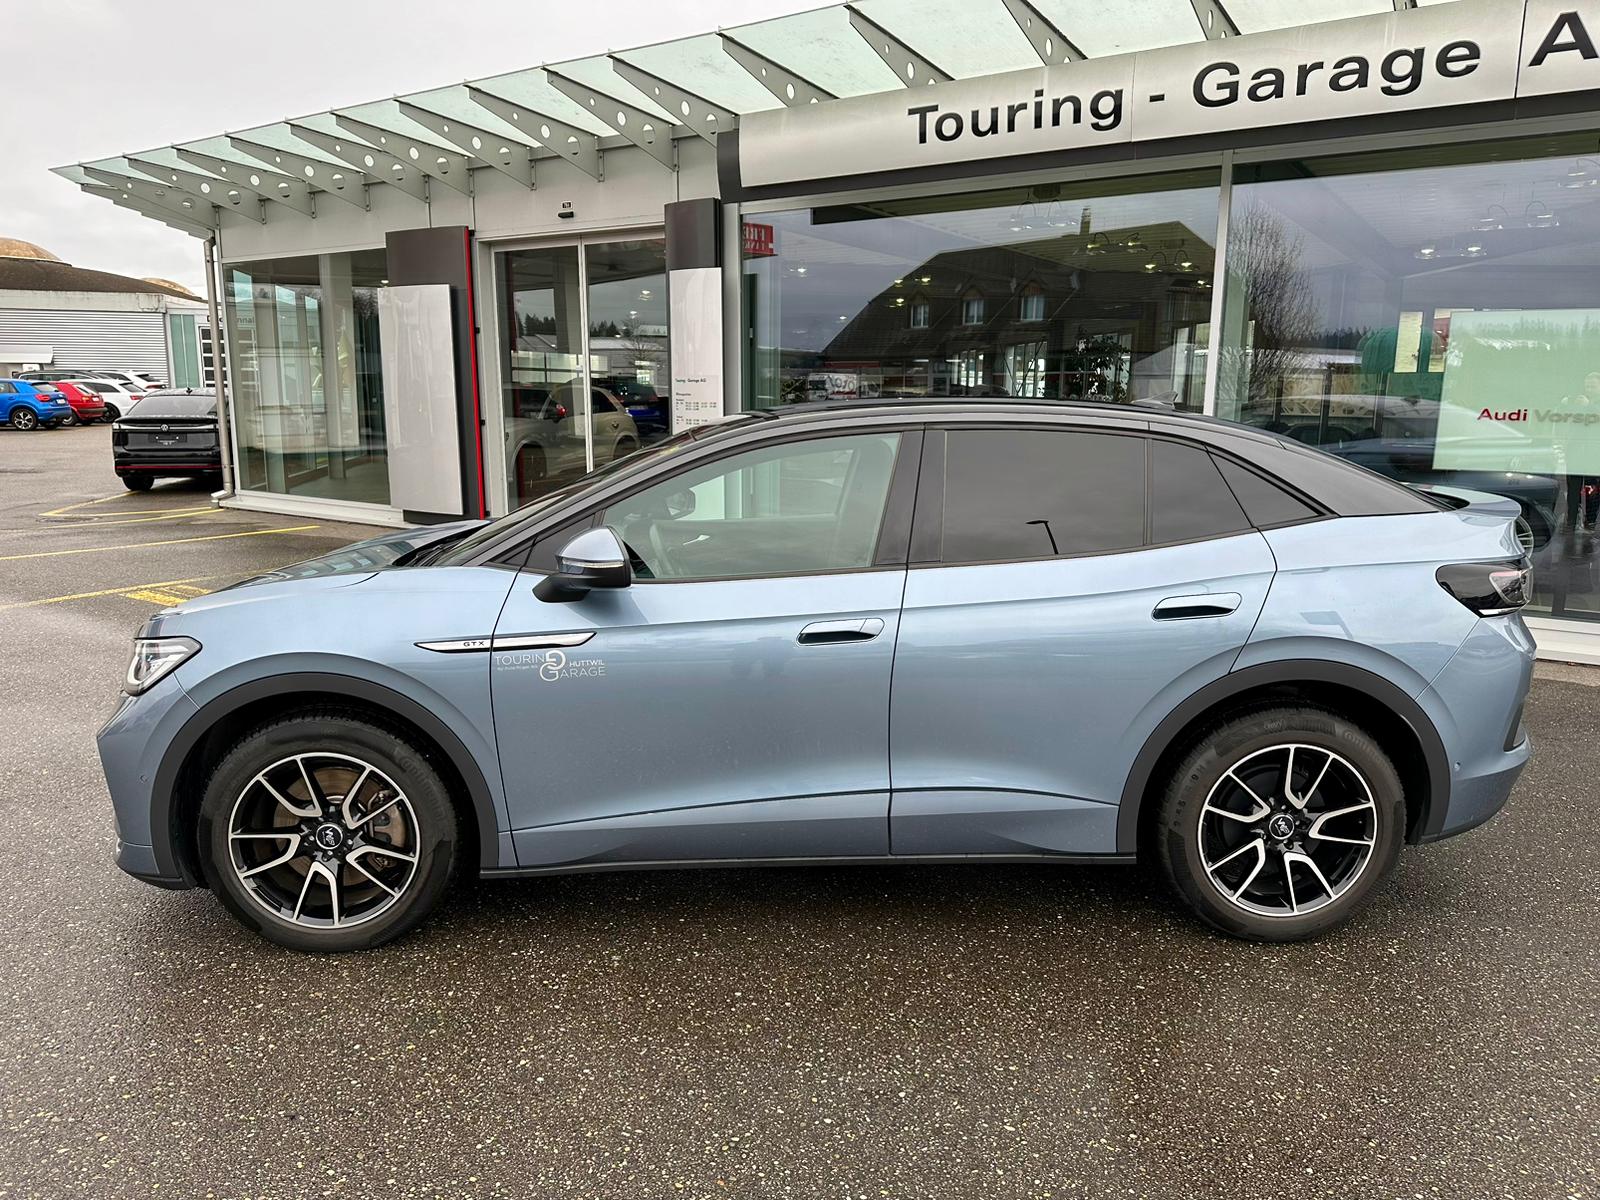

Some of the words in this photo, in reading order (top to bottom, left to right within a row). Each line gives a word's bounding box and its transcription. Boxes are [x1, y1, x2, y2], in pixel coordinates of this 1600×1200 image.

[907, 89, 1124, 145] Touring
[1193, 40, 1481, 107] Garage
[1528, 11, 1600, 67] A
[1477, 408, 1528, 422] Audi
[540, 662, 606, 682] GARAGE
[569, 659, 605, 668] HUTTWIL
